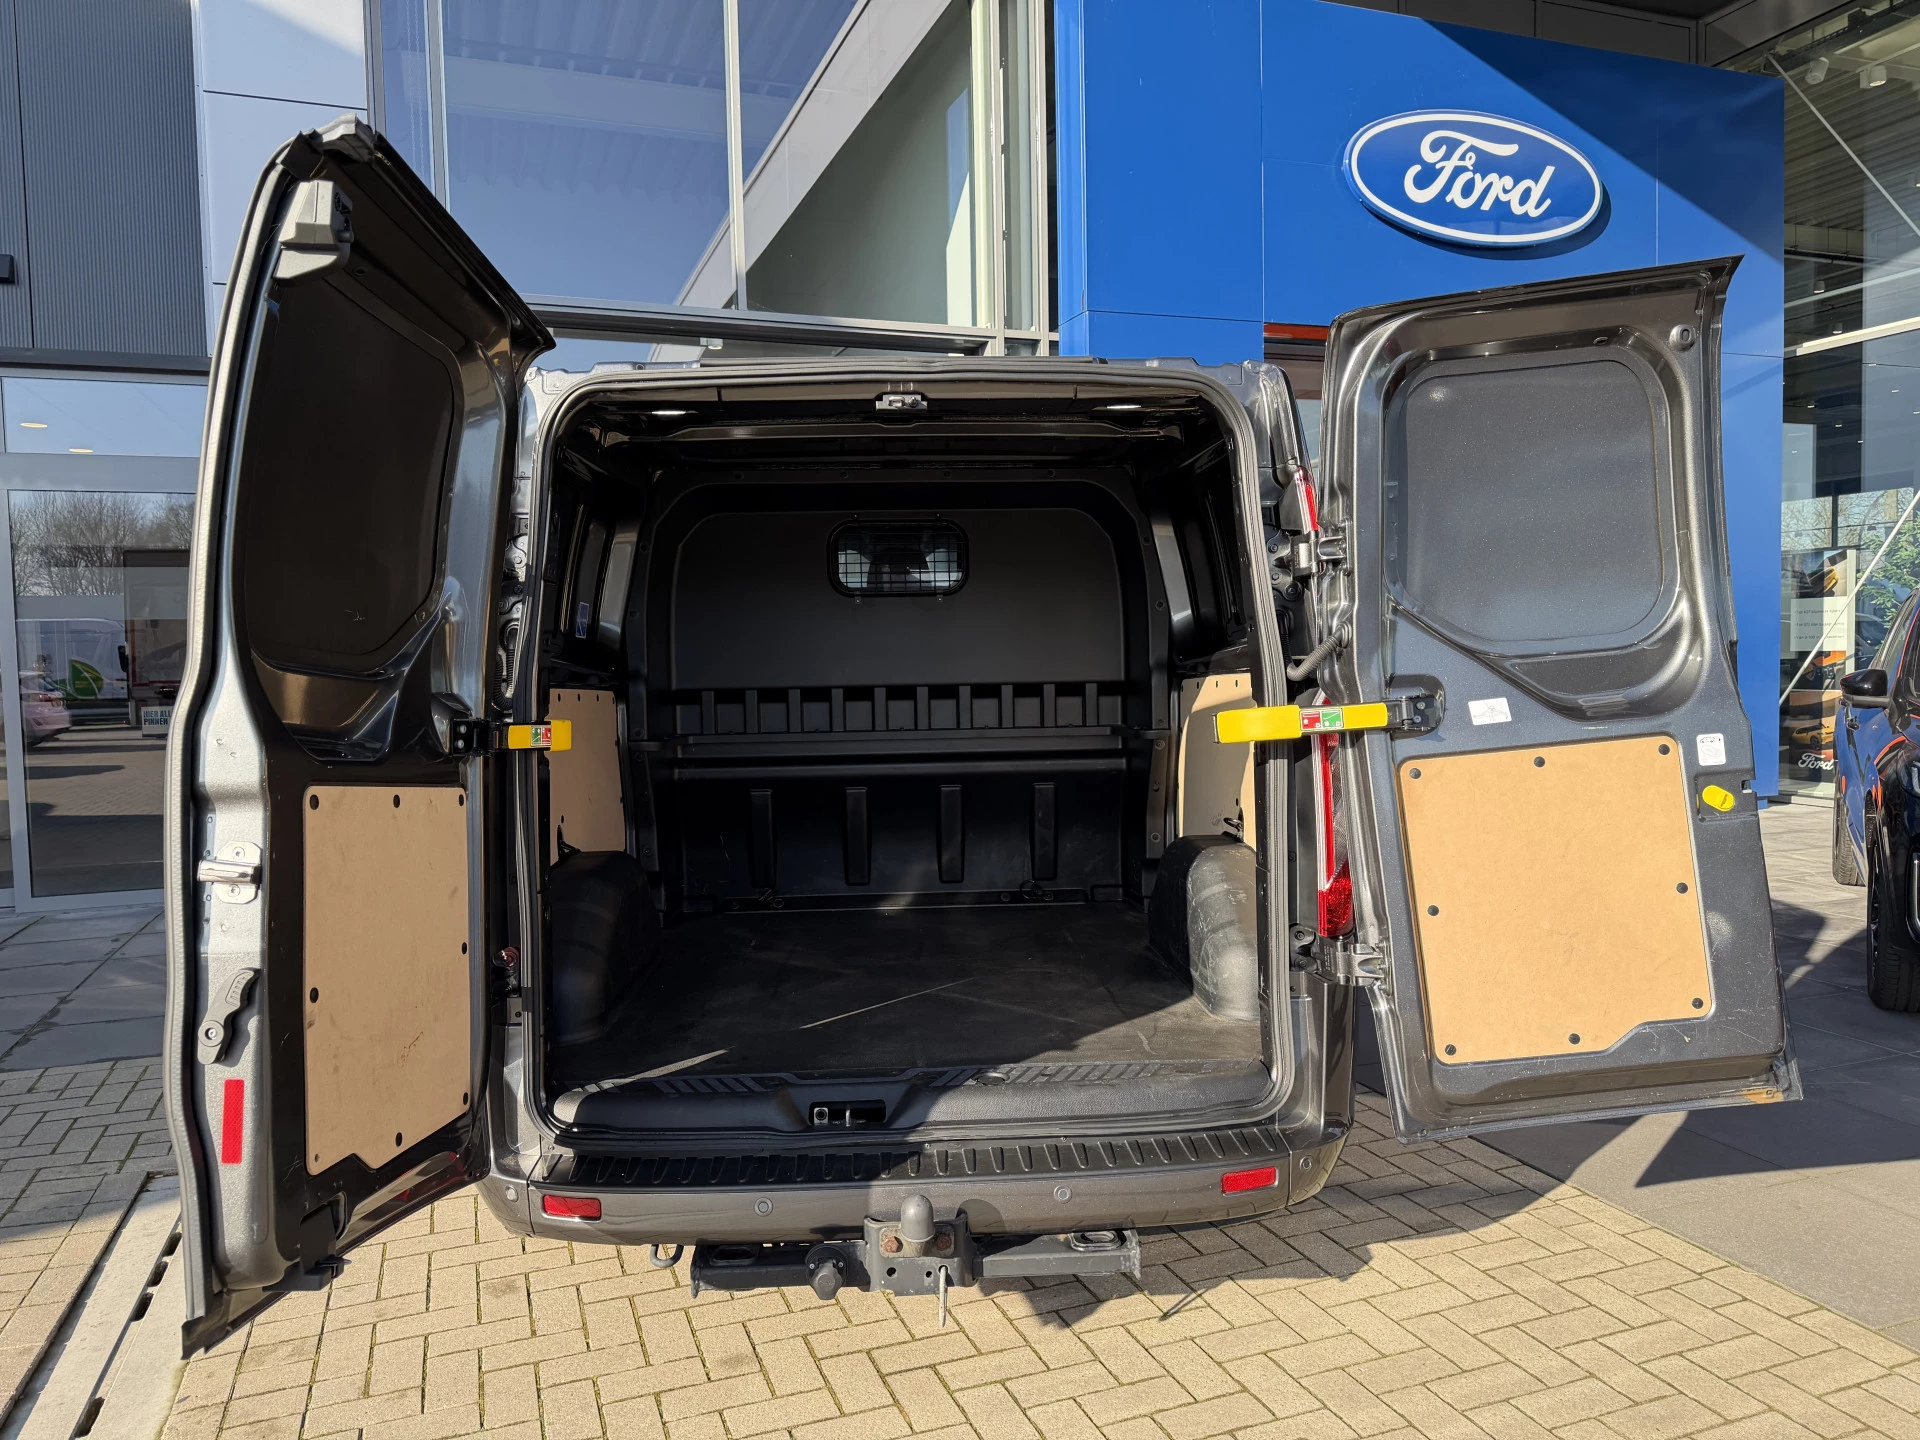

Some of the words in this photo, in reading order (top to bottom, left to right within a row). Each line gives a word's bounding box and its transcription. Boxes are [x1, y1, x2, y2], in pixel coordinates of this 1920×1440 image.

[1404, 130, 1556, 217] Ford
[143, 718, 169, 726] PINNEN
[1798, 752, 1835, 770] Ford
